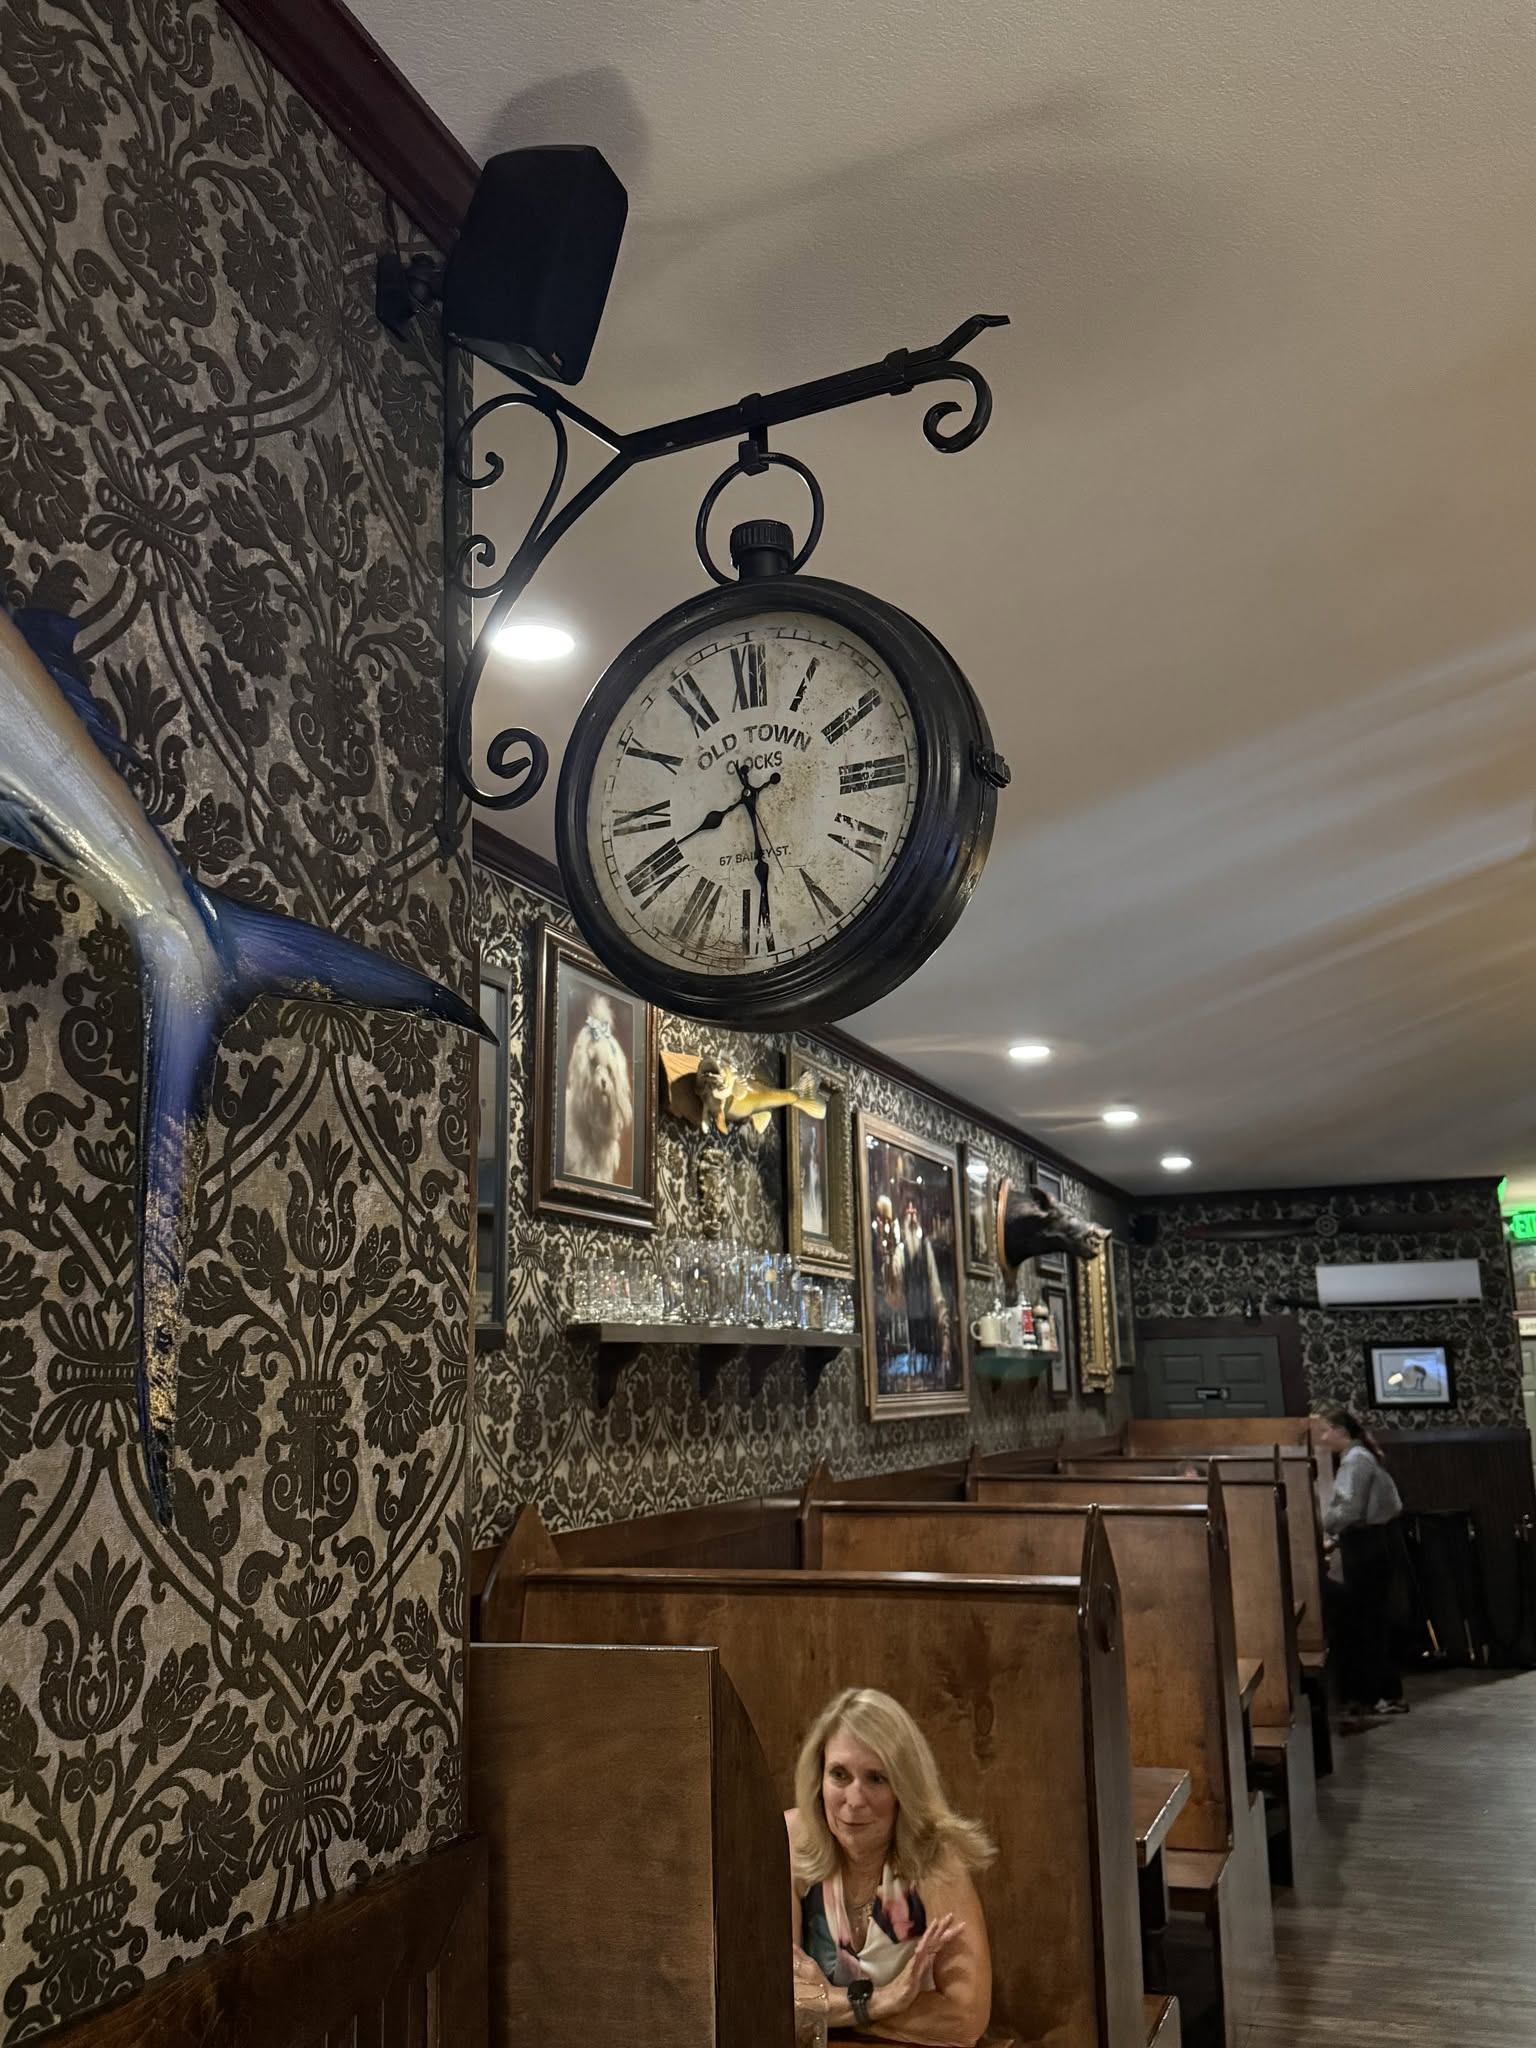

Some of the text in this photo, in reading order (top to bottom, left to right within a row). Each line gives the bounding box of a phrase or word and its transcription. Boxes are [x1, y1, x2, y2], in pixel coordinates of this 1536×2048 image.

[667, 671, 720, 739] XI
[730, 644, 768, 713] XII
[820, 687, 882, 745] II
[625, 737, 684, 776] X
[698, 723, 812, 770] OLD TOWN
[838, 754, 906, 795] III
[612, 799, 671, 837] IX
[624, 837, 690, 911] VIII
[719, 845, 792, 866] 67 BAIEY ST.
[671, 876, 723, 950] VII
[799, 867, 844, 925] V
